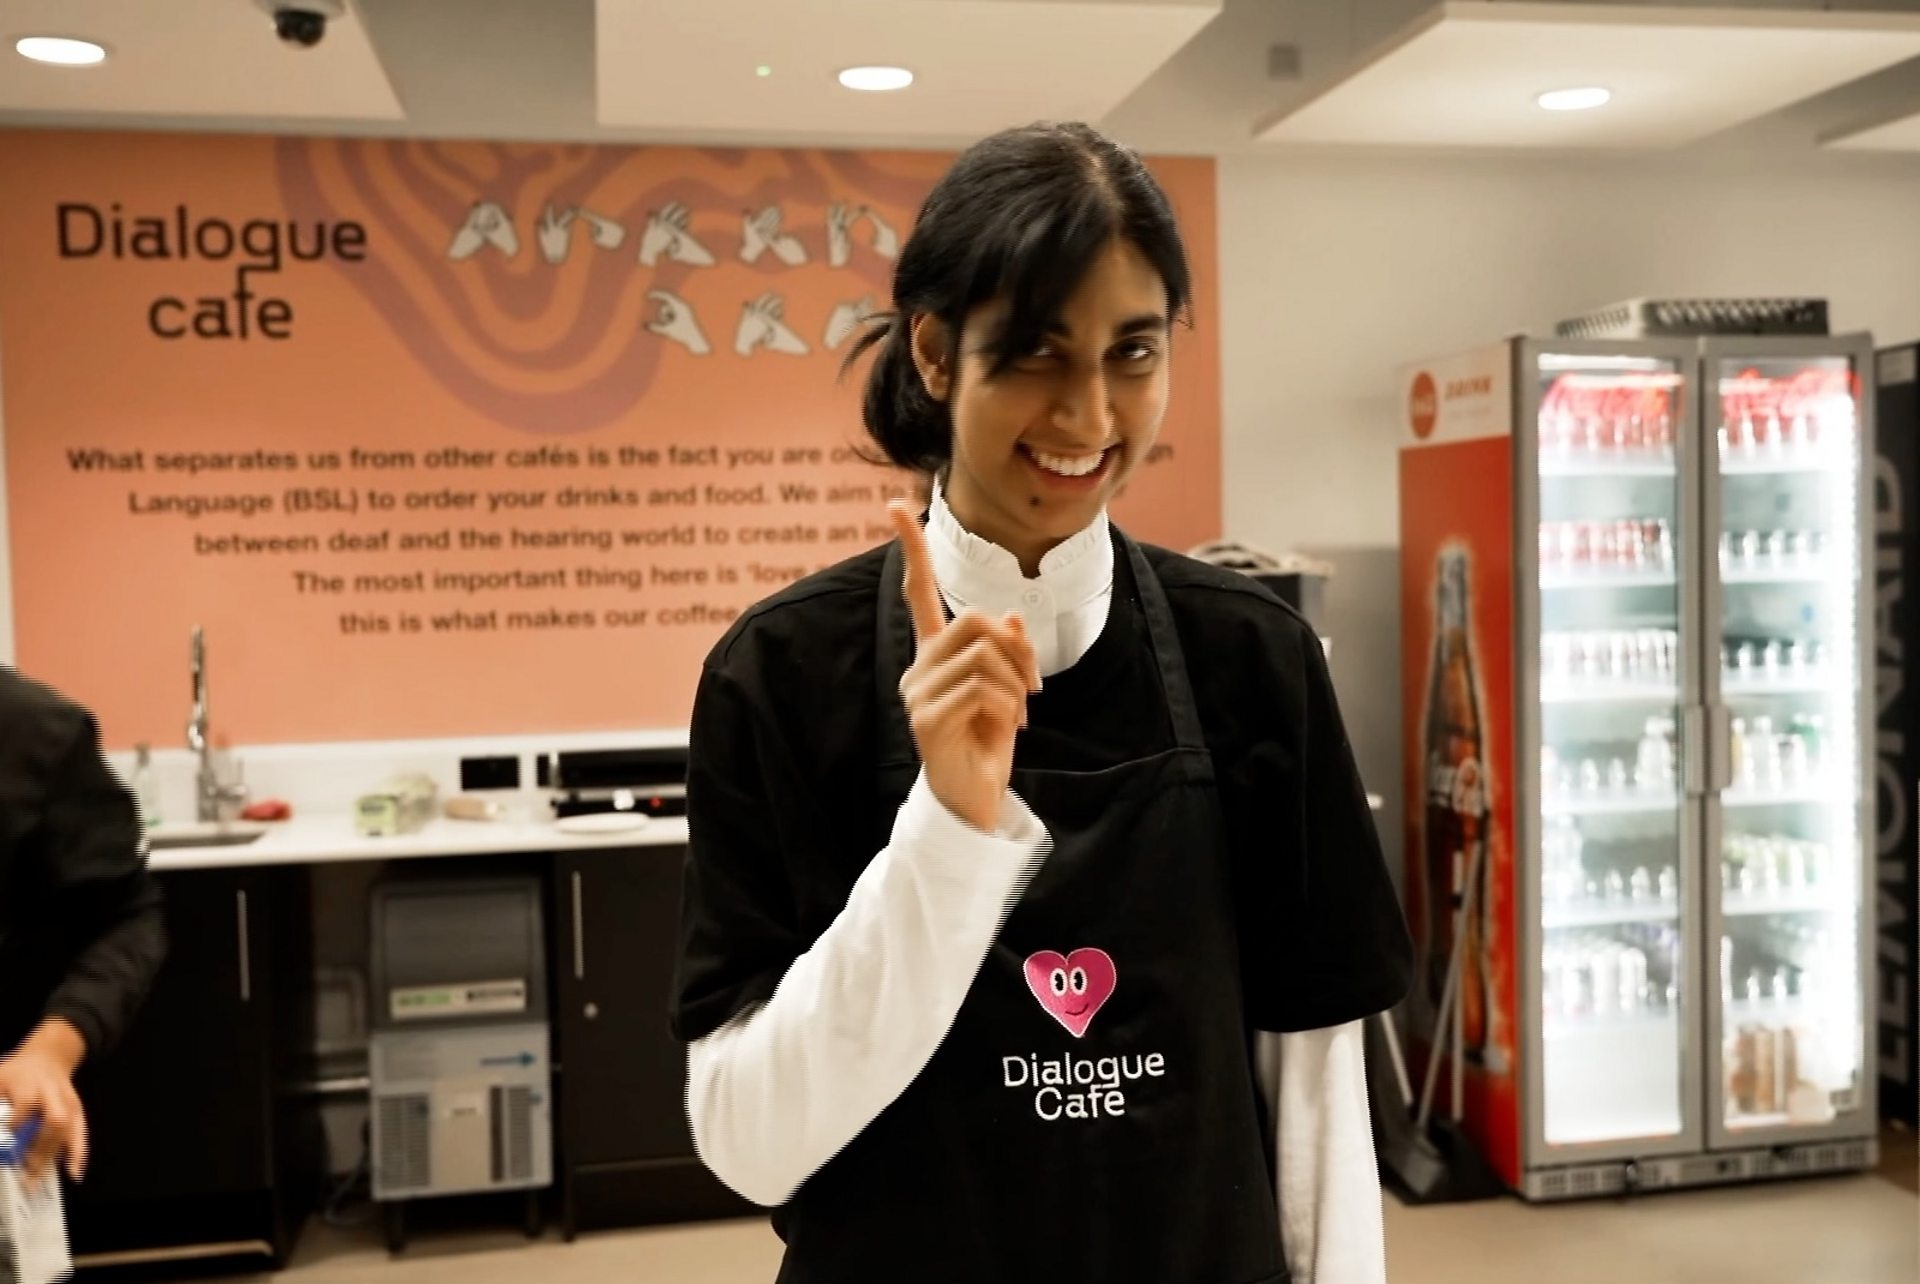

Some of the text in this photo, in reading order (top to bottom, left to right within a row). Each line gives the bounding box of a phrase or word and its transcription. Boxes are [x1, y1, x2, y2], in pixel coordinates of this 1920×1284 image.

[56, 202, 367, 271] Dialogue
[148, 264, 293, 340] cafe
[67, 450, 144, 472] What
[154, 450, 298, 475] separates
[308, 452, 341, 470] us
[350, 447, 415, 468] from
[424, 447, 495, 468] other
[505, 446, 579, 468] cafés
[588, 446, 610, 467] is
[618, 446, 660, 466] the
[669, 446, 718, 465] fact
[727, 450, 773, 469] you
[782, 450, 822, 465] are
[128, 492, 273, 517] Language
[284, 488, 358, 515] (BSL)
[368, 490, 396, 511] to
[404, 488, 476, 510] order
[487, 493, 546, 514] your
[556, 486, 639, 508] drinks
[648, 486, 696, 507] and
[705, 485, 767, 506] food.
[779, 485, 818, 503] We
[827, 482, 872, 503] aim
[194, 533, 319, 555] between
[328, 531, 389, 551] deaf
[399, 530, 450, 550] and
[459, 529, 502, 549] the
[510, 527, 612, 553] hearing
[621, 525, 696, 546] world
[704, 526, 729, 544] to
[738, 524, 818, 545] create
[827, 527, 859, 543] an
[292, 571, 345, 593] The
[354, 572, 423, 592] most
[433, 569, 566, 596] important
[575, 567, 642, 592] thing
[650, 566, 708, 585] here
[716, 563, 738, 583] is
[339, 604, 739, 636] this is what makes our coffee
[1002, 1052, 1165, 1088] Dialogue
[1035, 1084, 1125, 1121] Cafe
